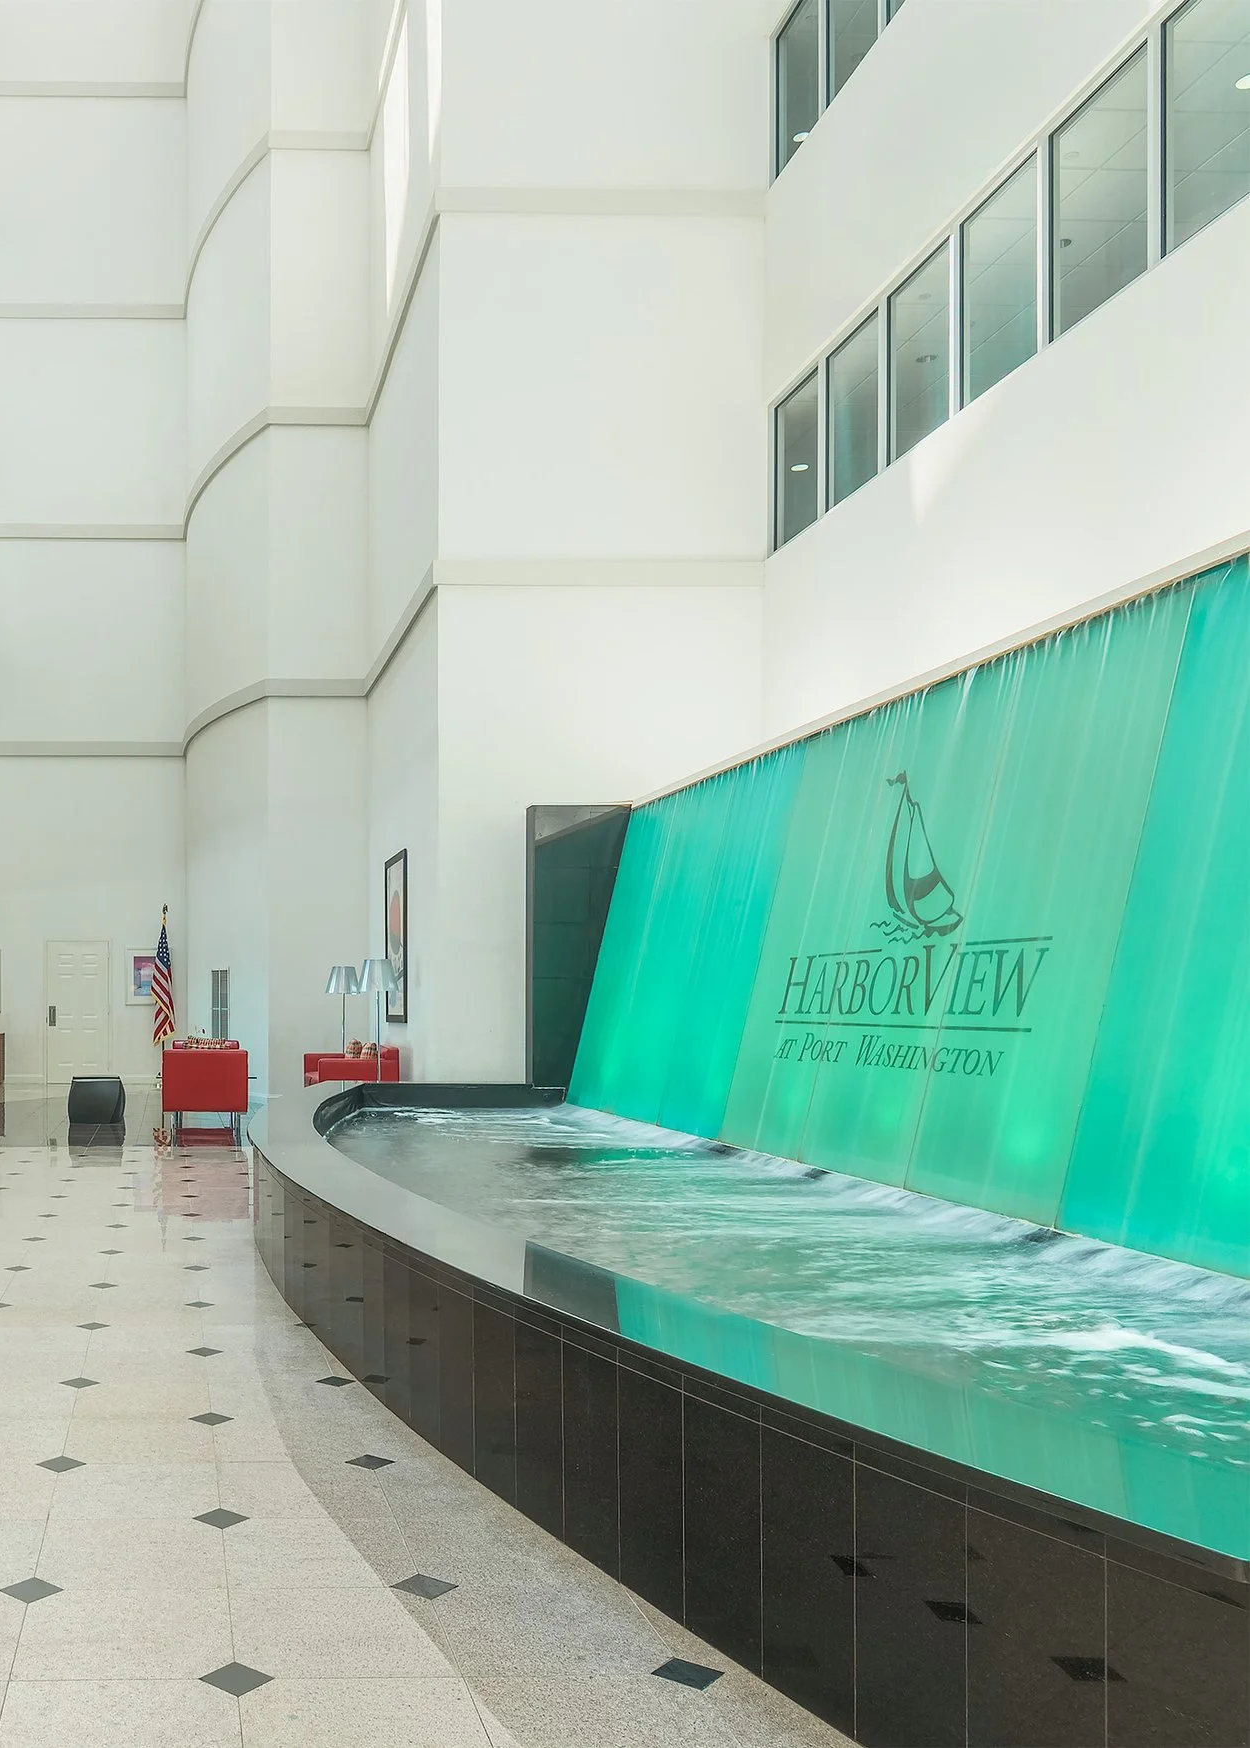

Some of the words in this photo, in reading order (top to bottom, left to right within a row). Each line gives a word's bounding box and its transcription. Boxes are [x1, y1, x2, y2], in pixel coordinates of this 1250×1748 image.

[778, 943, 1049, 1017] HARBORVIEW
[774, 1039, 798, 1060] AT
[798, 1032, 848, 1063] PORT
[855, 1035, 1005, 1077] WASHINGTON
